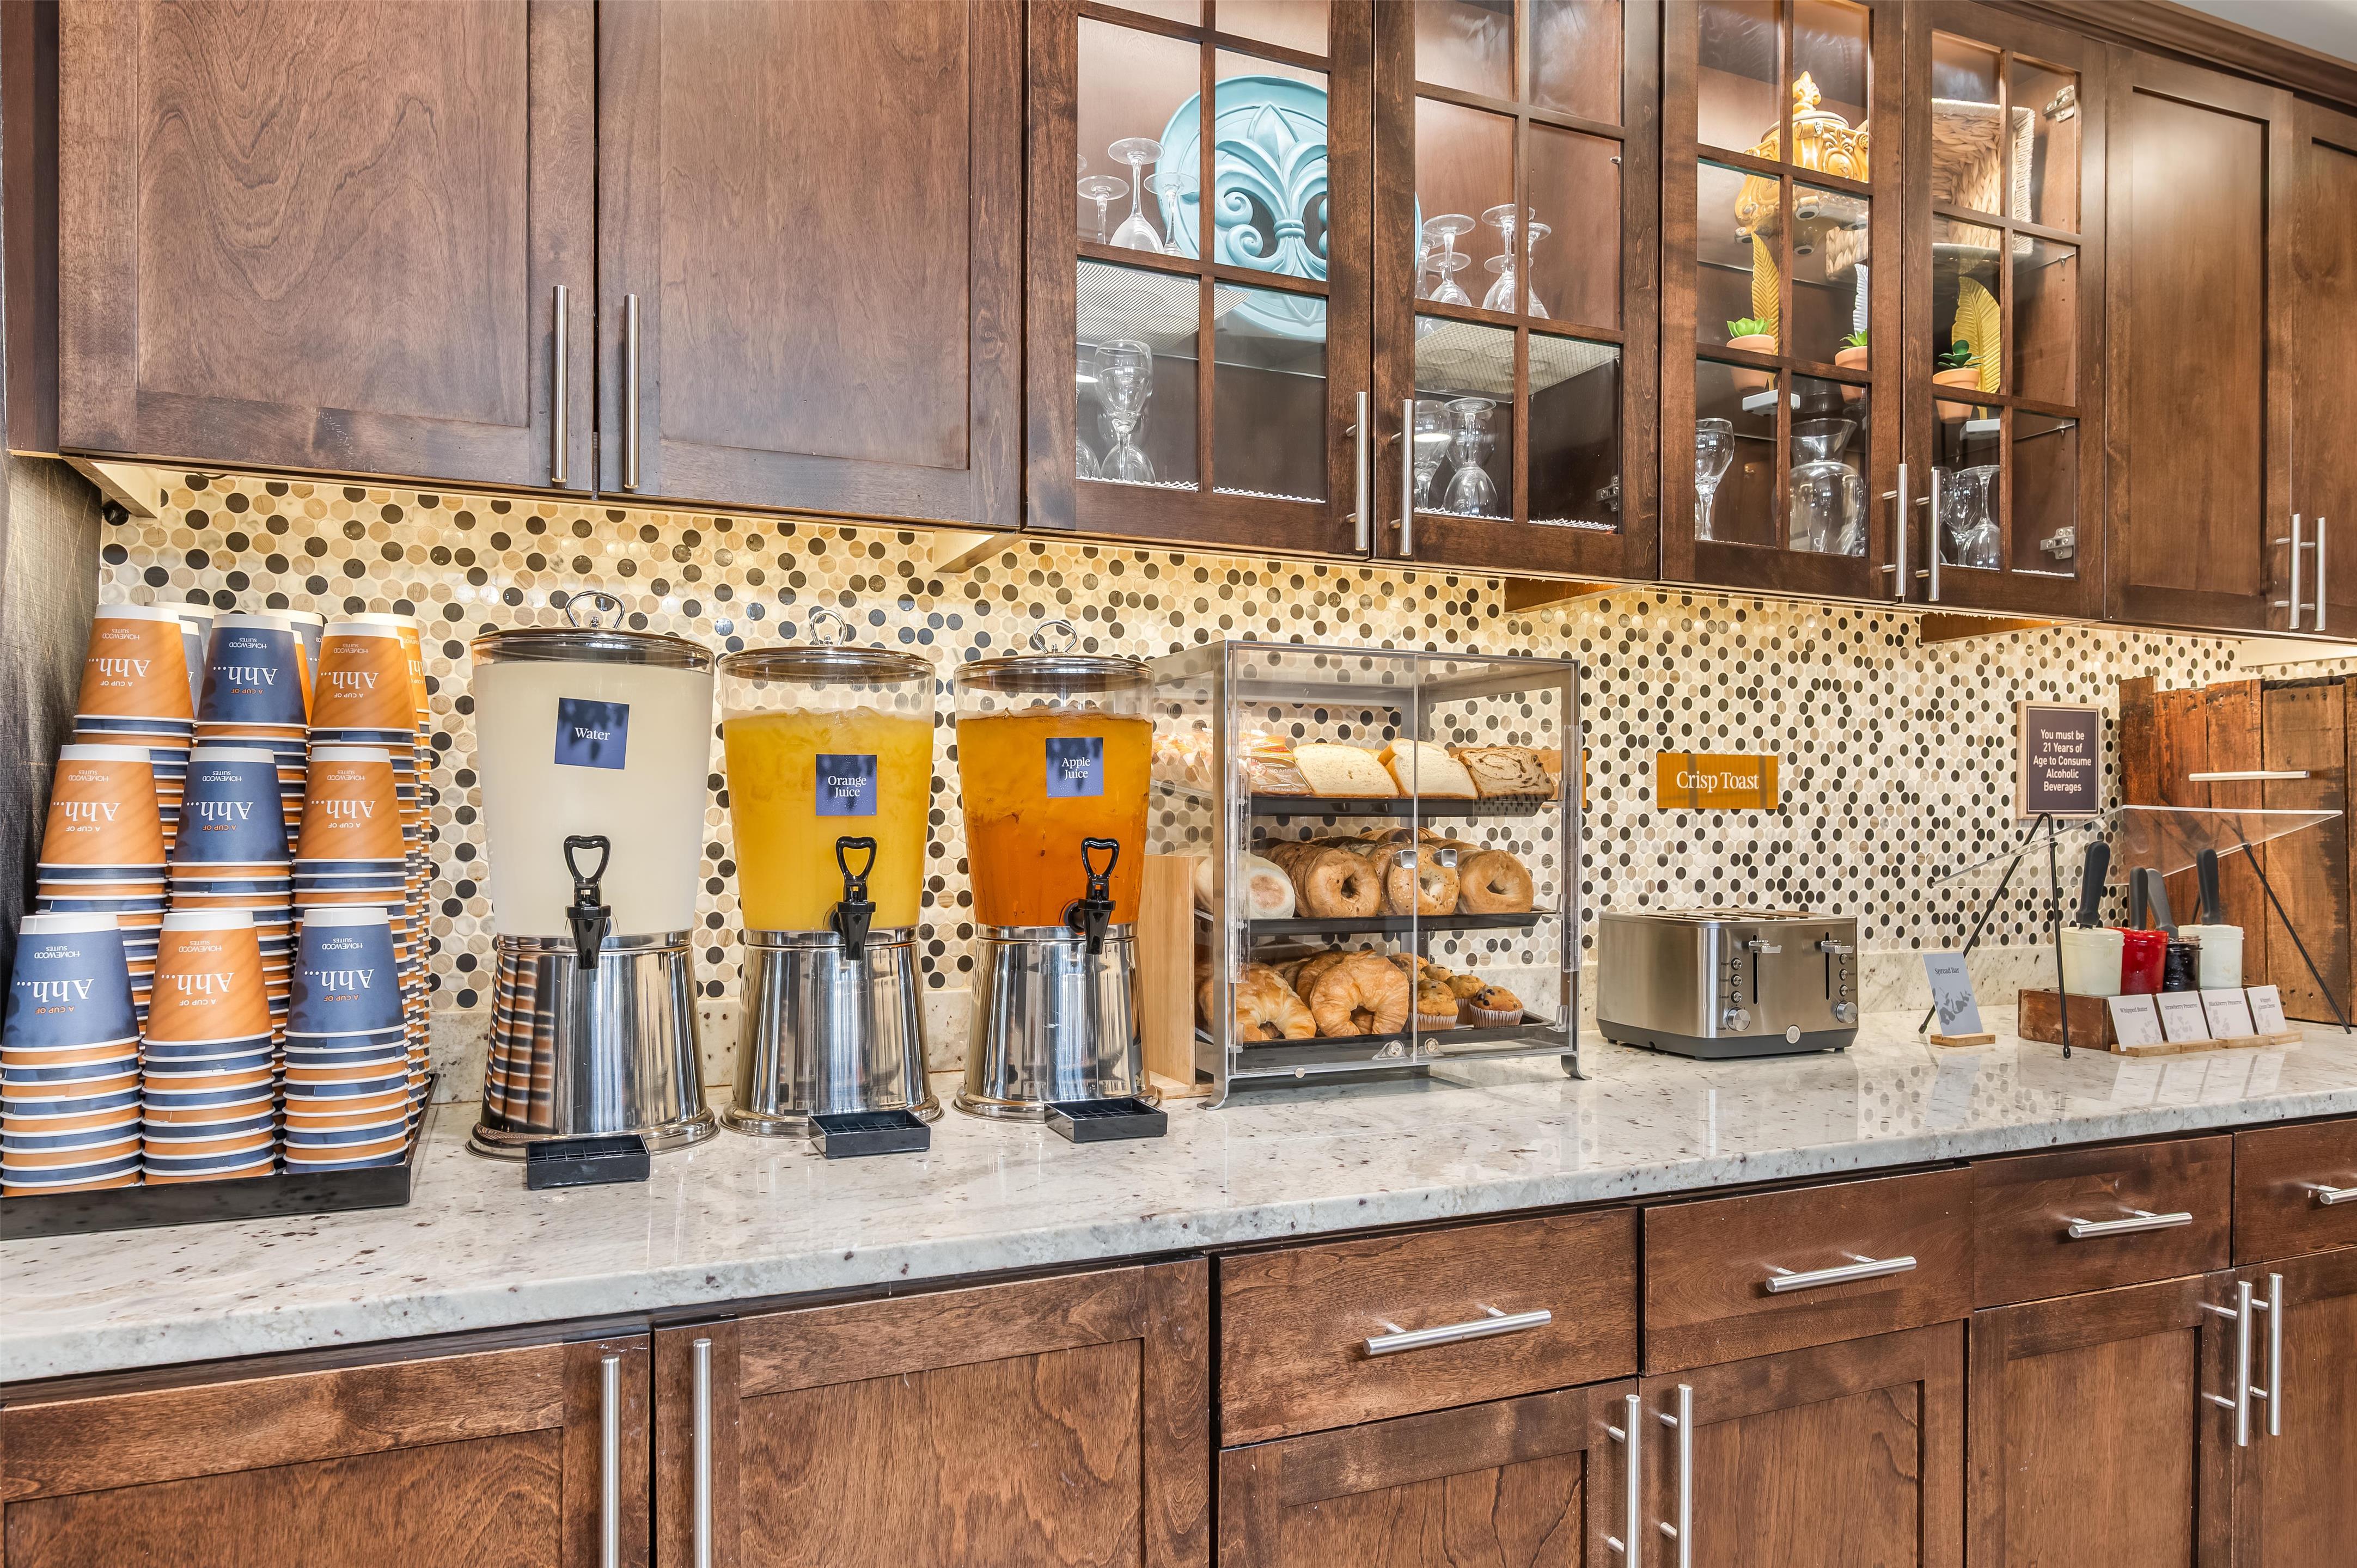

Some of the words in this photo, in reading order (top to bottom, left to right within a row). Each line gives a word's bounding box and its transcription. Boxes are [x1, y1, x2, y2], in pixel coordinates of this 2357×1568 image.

[575, 727, 610, 740] Water
[2041, 729, 2054, 739] You
[2056, 731, 2074, 740] must
[2075, 730, 2085, 740] be
[2043, 743, 2051, 752] 21
[2053, 743, 2073, 752] Years
[2075, 743, 2083, 752] of
[1061, 757, 1091, 769] Apple
[2034, 755, 2048, 767] Age
[2049, 756, 2056, 765] to
[2058, 756, 2091, 765] Consume
[1065, 769, 1088, 780] Juice
[2046, 769, 2079, 779] Alcoholic
[828, 775, 866, 787] Orange
[1676, 770, 1718, 793] Crisp
[1720, 772, 1760, 789] Toast
[835, 787, 860, 798] Juice
[2044, 781, 2081, 794] Beverages
[34, 951, 81, 959] HOMEWOOD
[1934, 967, 1951, 976] Spread
